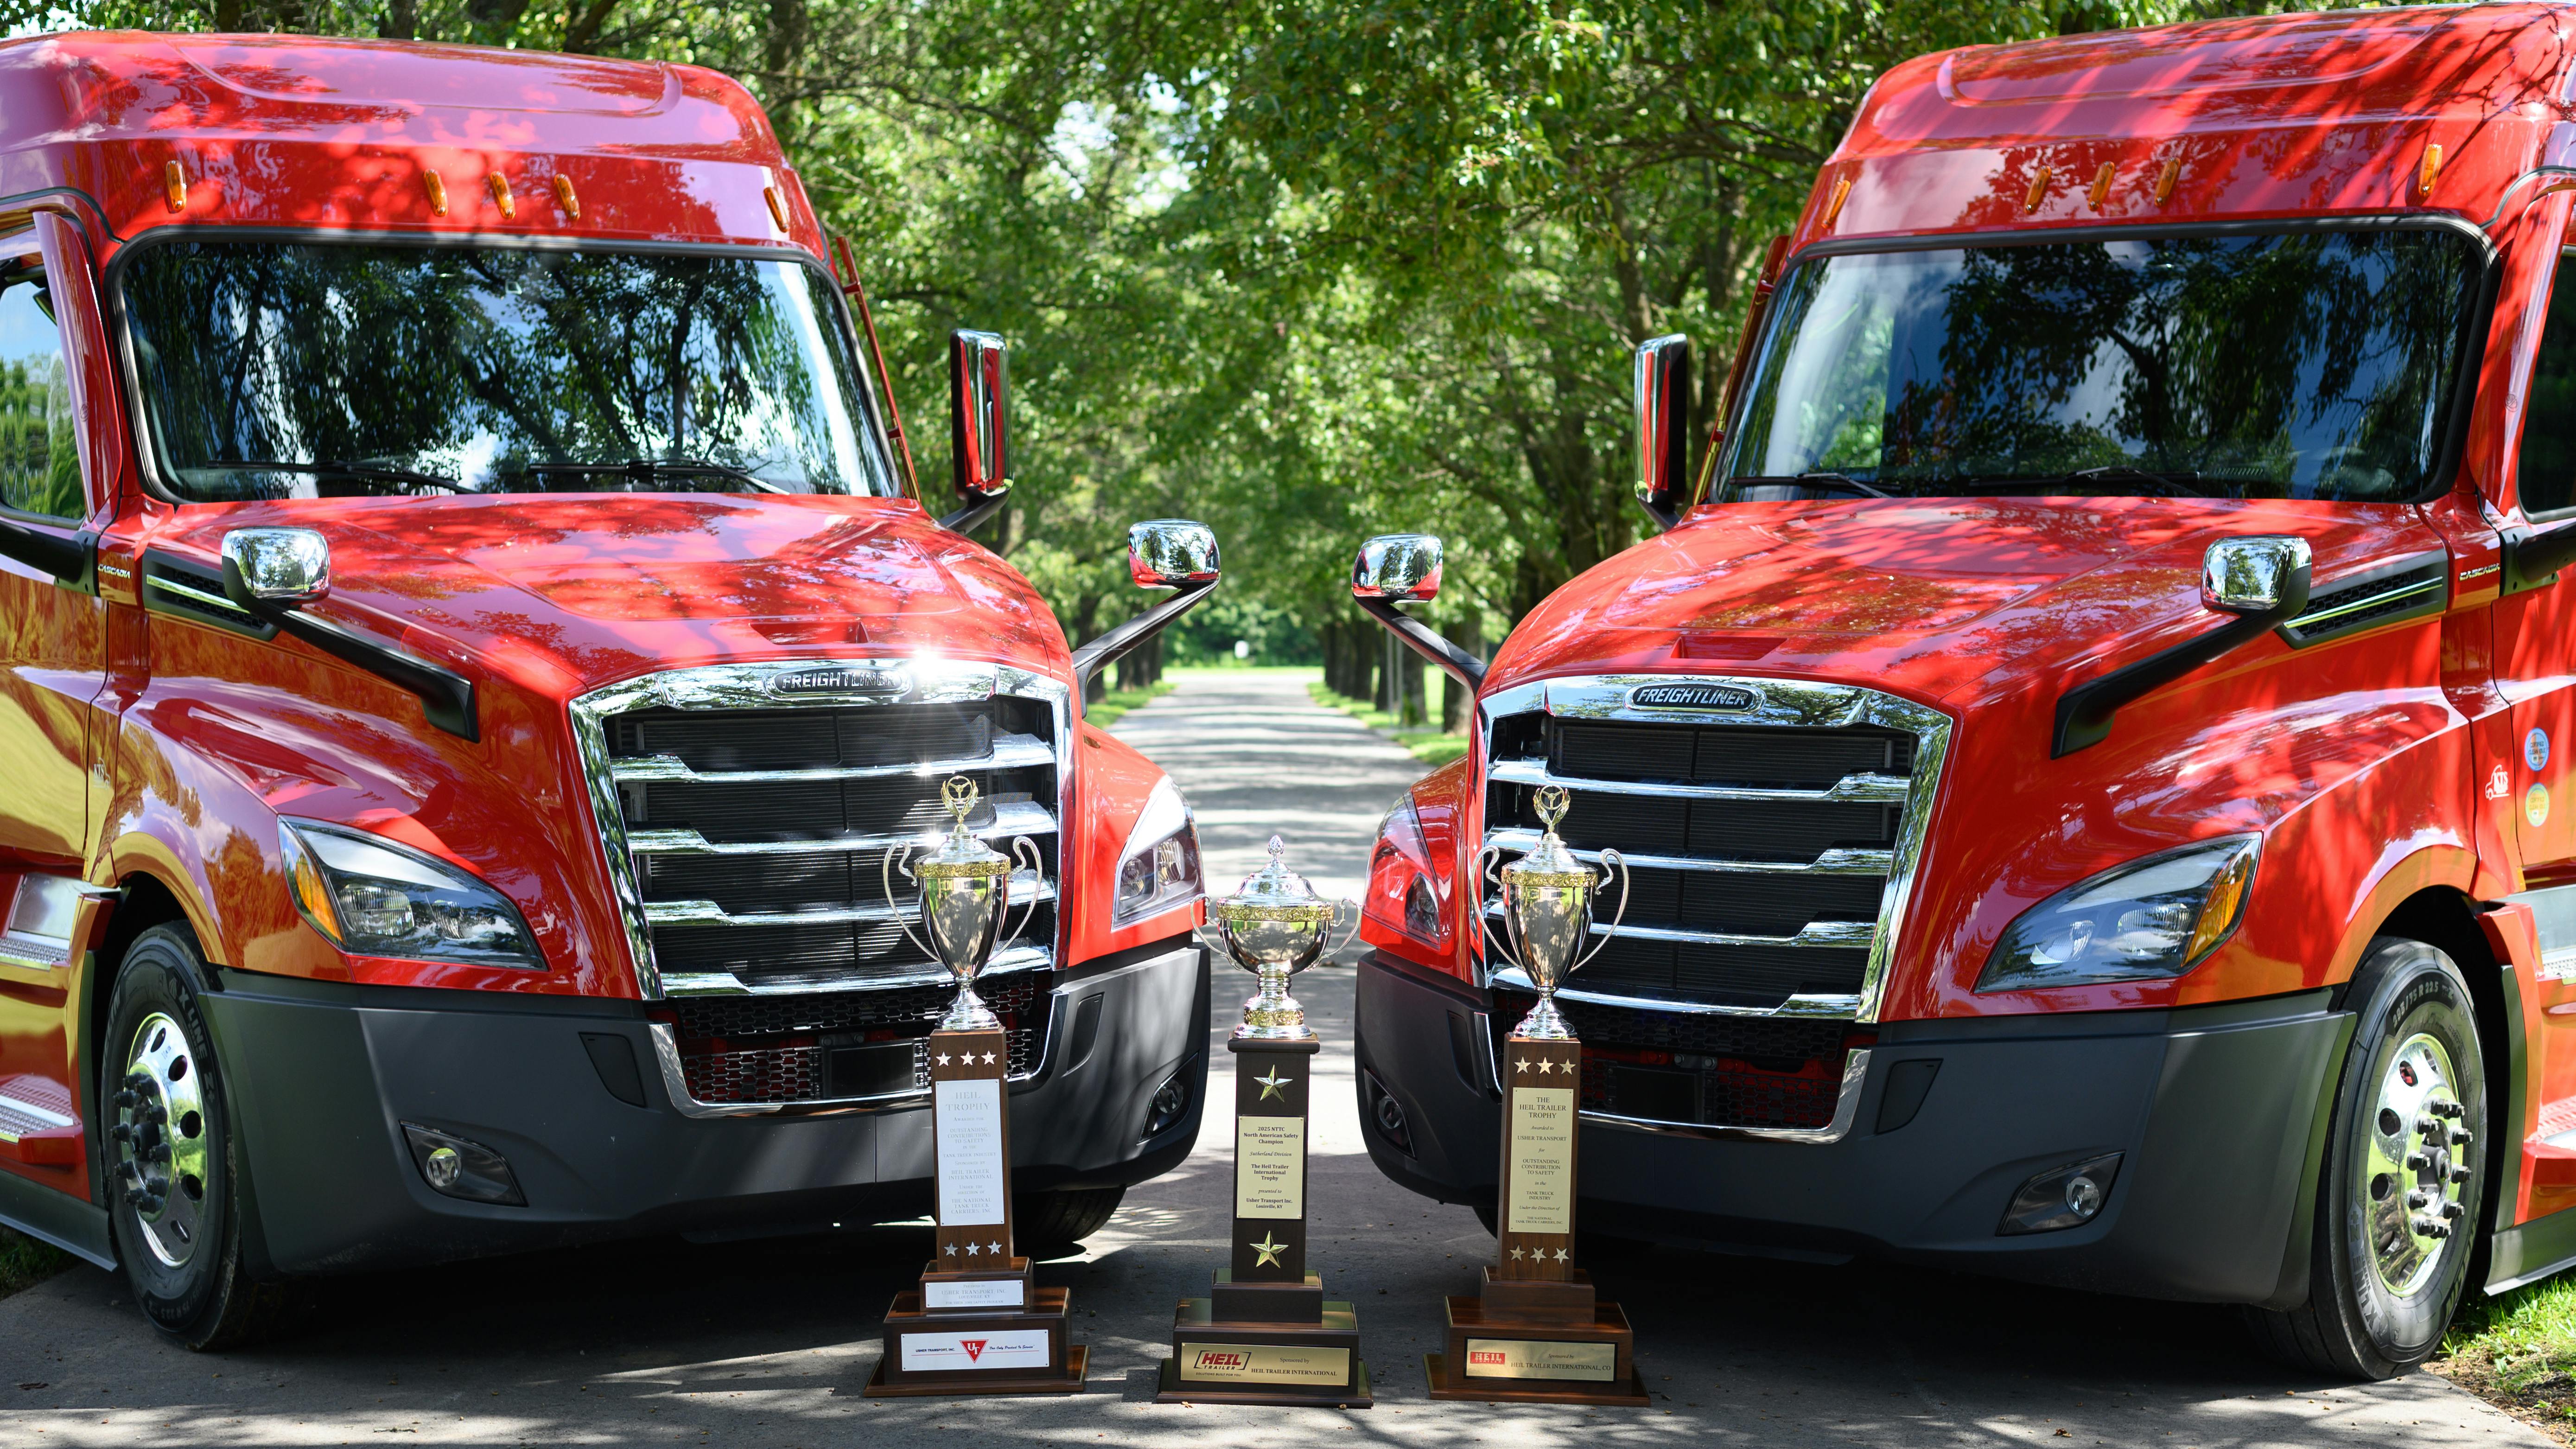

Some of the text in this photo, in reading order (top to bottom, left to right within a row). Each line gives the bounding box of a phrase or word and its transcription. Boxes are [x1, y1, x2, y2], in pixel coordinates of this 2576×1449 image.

[98, 564, 130, 579] CASCADIA
[782, 672, 896, 689] FREIGHTLINER
[1637, 688, 1749, 706] FREIGHTLINER
[94, 763, 104, 778] KTS
[2493, 771, 2508, 787] KTS
[2418, 984, 2423, 997] R
[188, 1008, 207, 1060] LINE
[946, 1103, 990, 1111] TROPHY
[2353, 1254, 2370, 1309] LINE
[1202, 1353, 1241, 1366] HEIL
